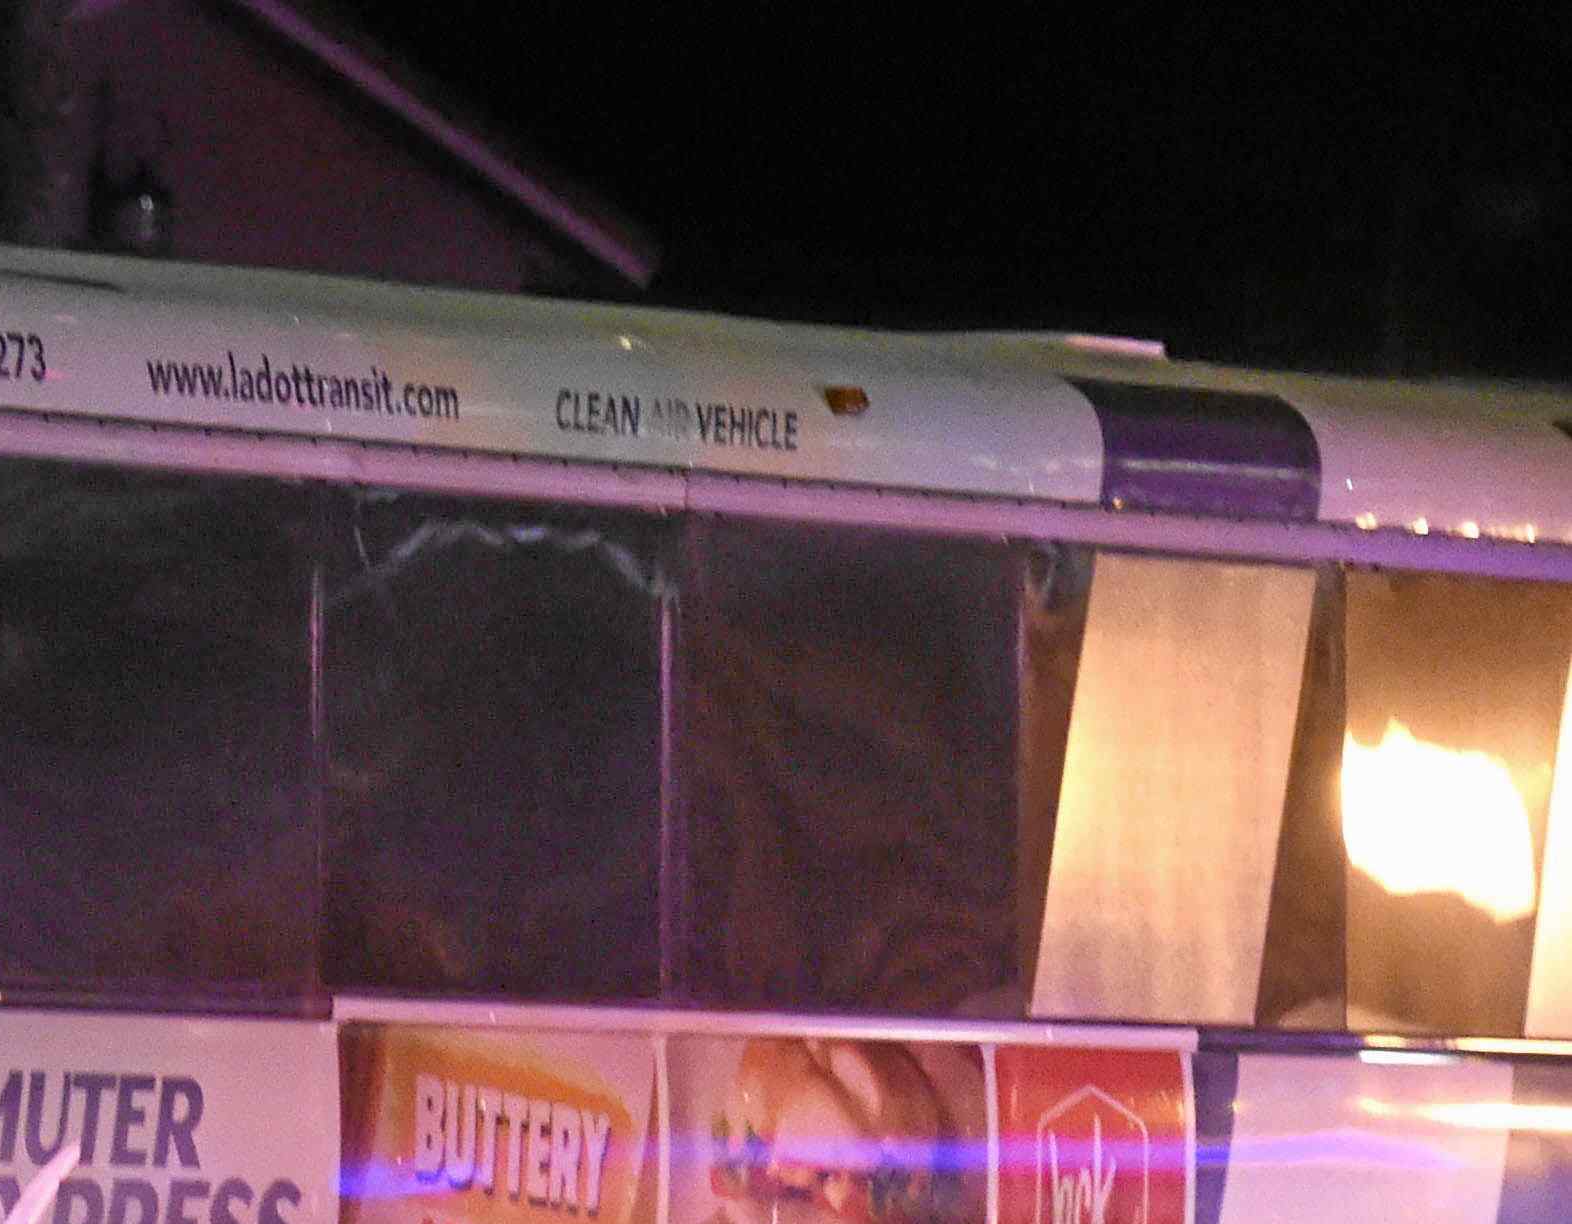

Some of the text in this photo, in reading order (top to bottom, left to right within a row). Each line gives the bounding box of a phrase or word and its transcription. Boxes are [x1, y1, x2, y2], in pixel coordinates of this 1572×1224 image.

[146, 351, 460, 420] www.ladottransit.com
[556, 386, 641, 438] CLEAN
[696, 400, 799, 451] VEHICLE
[412, 1071, 611, 1218] BUTTERY
